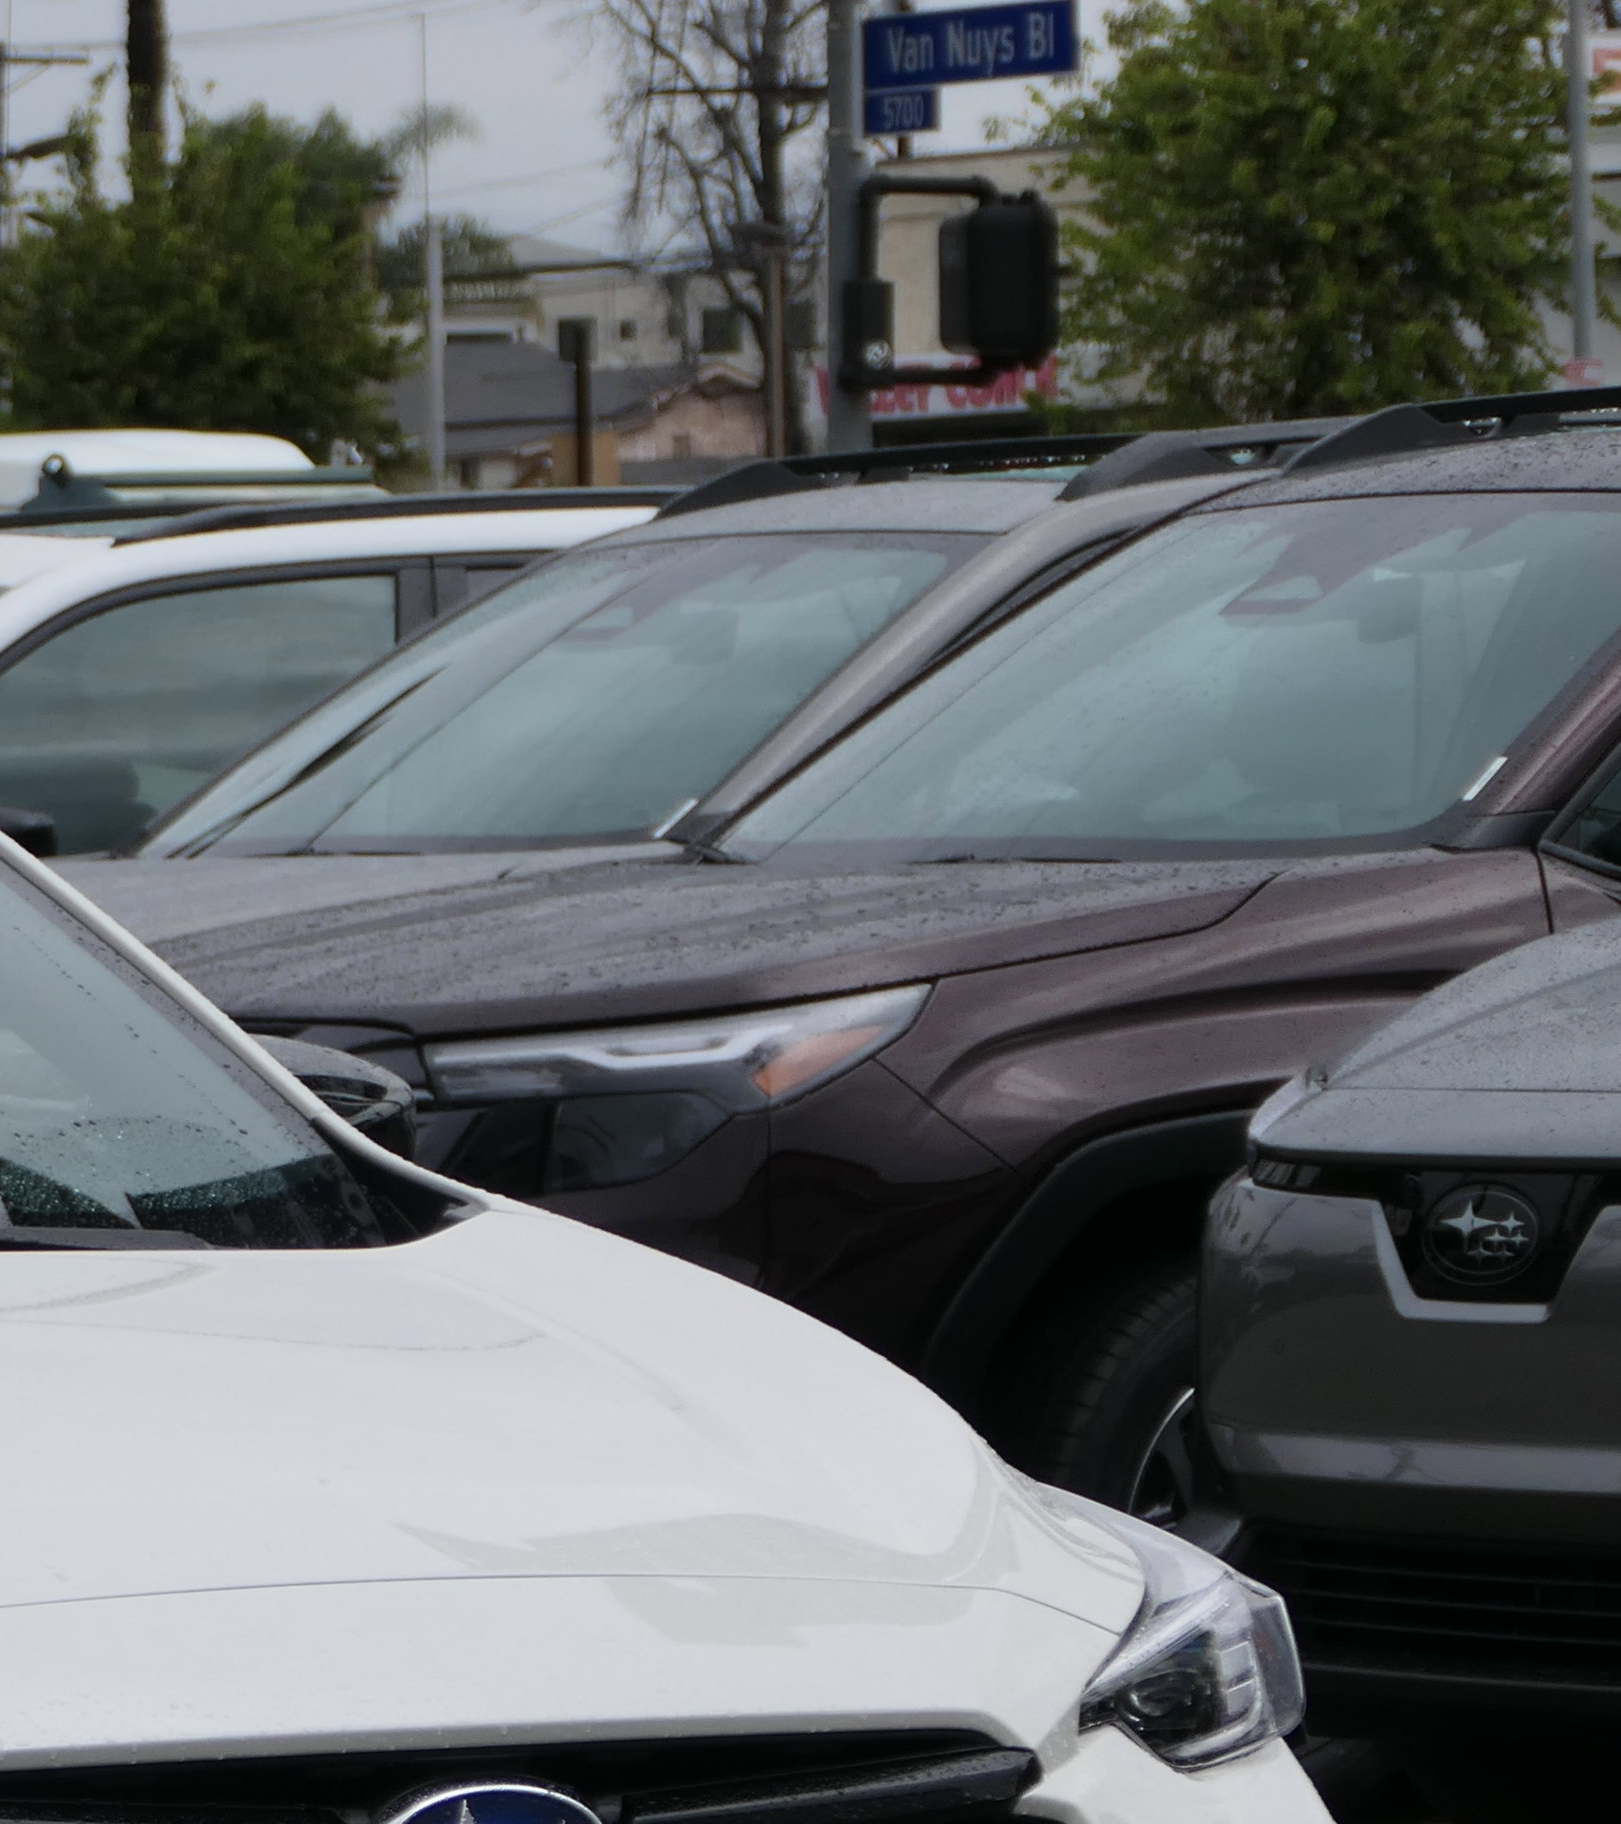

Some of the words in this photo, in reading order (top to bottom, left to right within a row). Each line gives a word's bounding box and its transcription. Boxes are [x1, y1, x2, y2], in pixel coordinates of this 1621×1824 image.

[887, 26, 934, 74] Van
[947, 19, 1015, 77] Nuys
[1028, 12, 1055, 60] Bl
[883, 94, 924, 129] 5700
